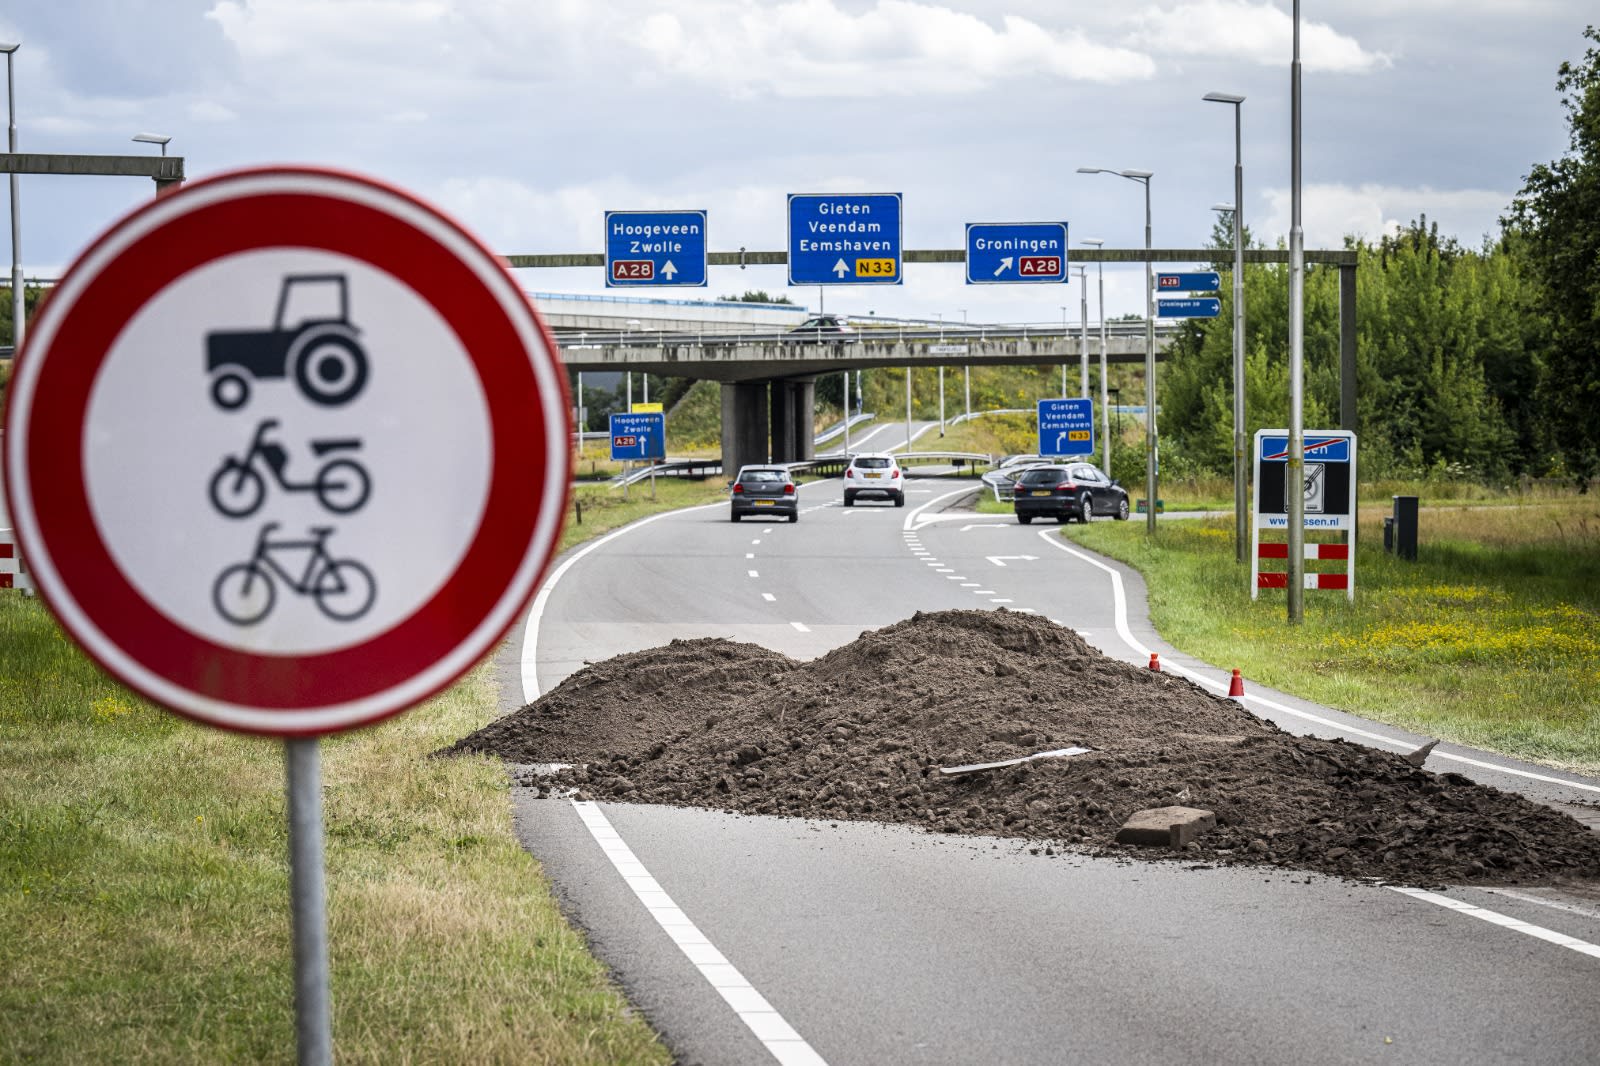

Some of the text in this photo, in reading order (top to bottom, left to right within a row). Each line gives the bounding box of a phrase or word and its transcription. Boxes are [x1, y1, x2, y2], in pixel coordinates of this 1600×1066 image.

[819, 203, 870, 215] Gieten
[614, 224, 699, 237] Hoogeveen
[809, 221, 880, 233] Veendam
[630, 241, 682, 253] Zwolle
[800, 240, 891, 251] Eemshaven
[976, 238, 1058, 252] Groningen
[1051, 403, 1079, 411] Gieten
[615, 417, 660, 425] Hoogeveen
